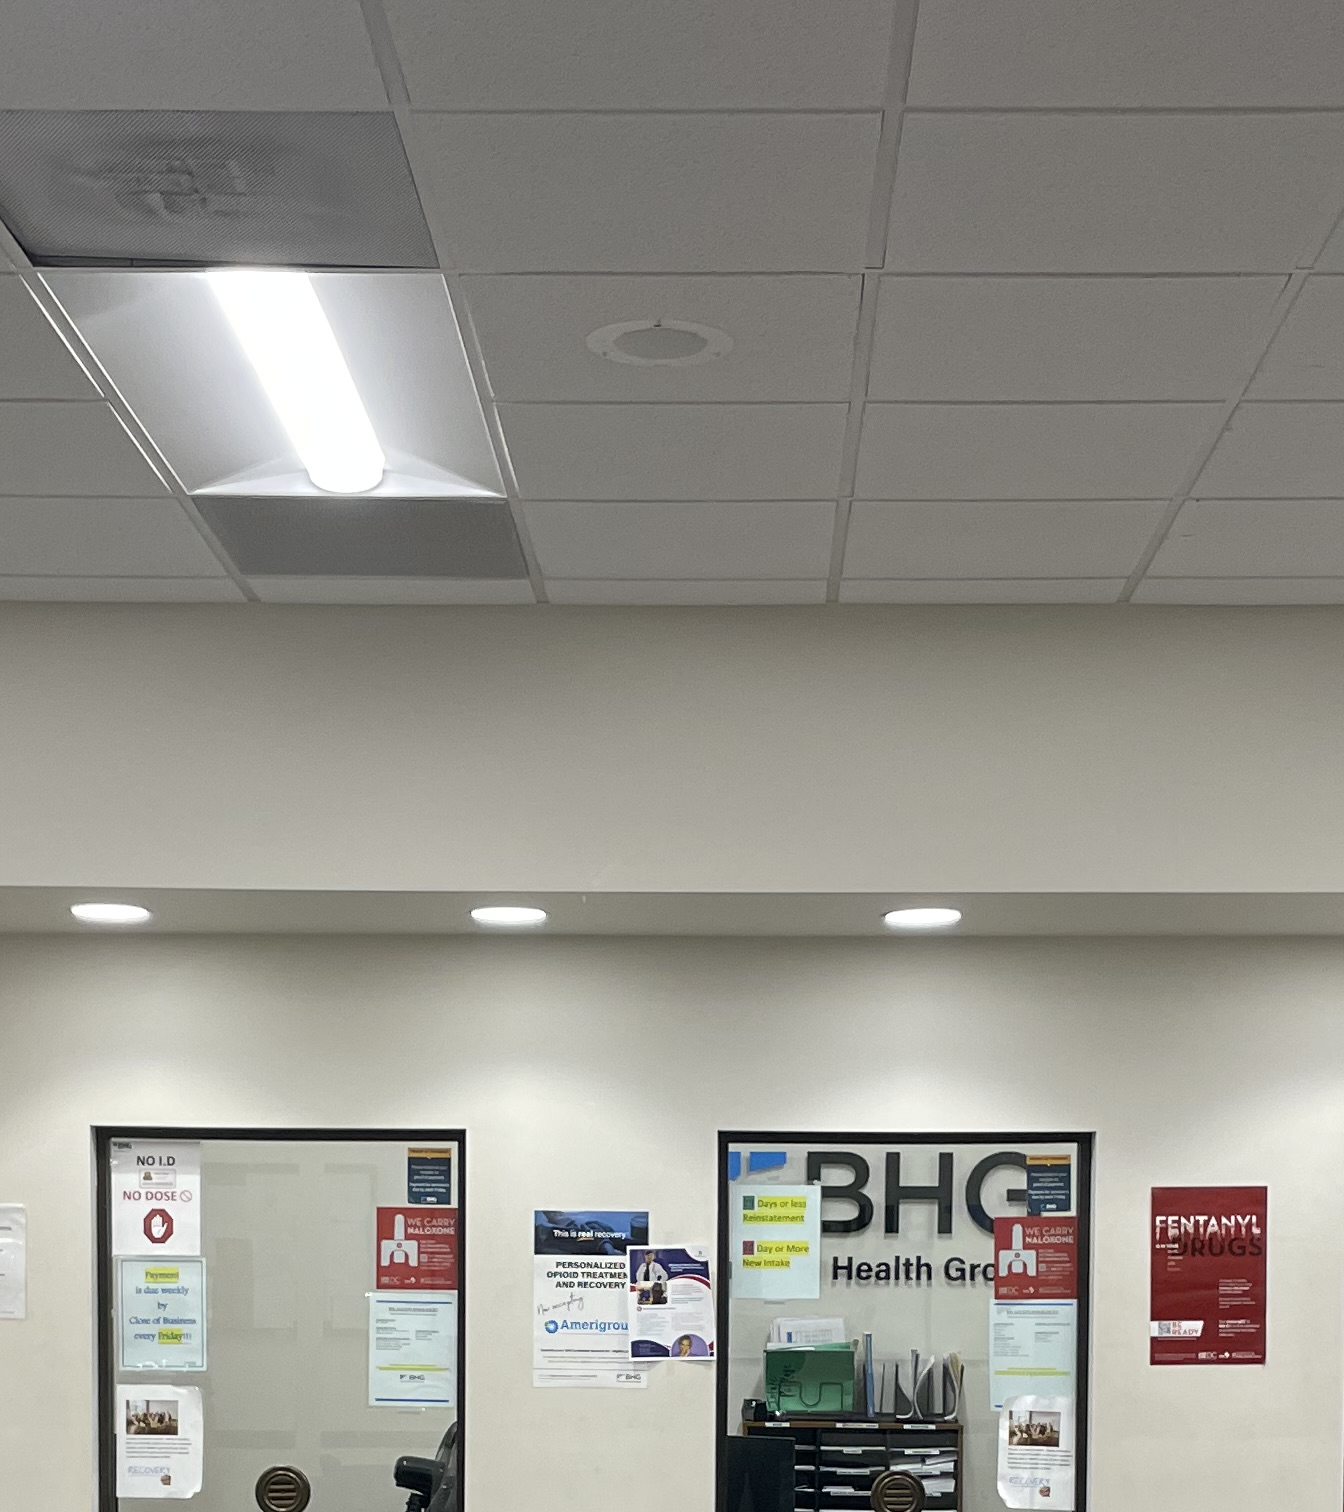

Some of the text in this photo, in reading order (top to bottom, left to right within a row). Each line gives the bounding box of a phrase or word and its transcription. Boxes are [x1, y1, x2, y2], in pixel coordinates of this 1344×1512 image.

[136, 1155, 156, 1166] NO
[123, 1190, 178, 1201] NO DOSE
[807, 1151, 1027, 1234] BHG
[757, 1199, 777, 1209] Days
[790, 1199, 807, 1209] less
[743, 1213, 805, 1222] Reinstatement
[407, 1218, 456, 1227] WE CARRY
[1155, 1214, 1262, 1240] FENTANYL
[407, 1226, 456, 1235] NALOXONE
[553, 1229, 569, 1238] This
[570, 1229, 577, 1237] is
[594, 1231, 626, 1239] recovery
[1025, 1226, 1074, 1236] WE CARRY
[1025, 1235, 1074, 1244] NALOXONE
[756, 1245, 773, 1255] Day
[786, 1244, 810, 1253] More
[1170, 1237, 1263, 1257] DRUGS
[555, 1261, 626, 1269] PERSONALIZED
[742, 1259, 790, 1267] New Intake
[832, 1255, 932, 1281] Health
[145, 1271, 179, 1280] Payment
[546, 1271, 579, 1279] OPIOID
[555, 1281, 626, 1289] AND RECOVERY
[136, 1285, 189, 1296] is due weekly
[157, 1301, 168, 1311] by
[129, 1316, 197, 1325] Close of Business
[134, 1333, 156, 1342] every
[128, 1465, 170, 1474] RECOVERY
